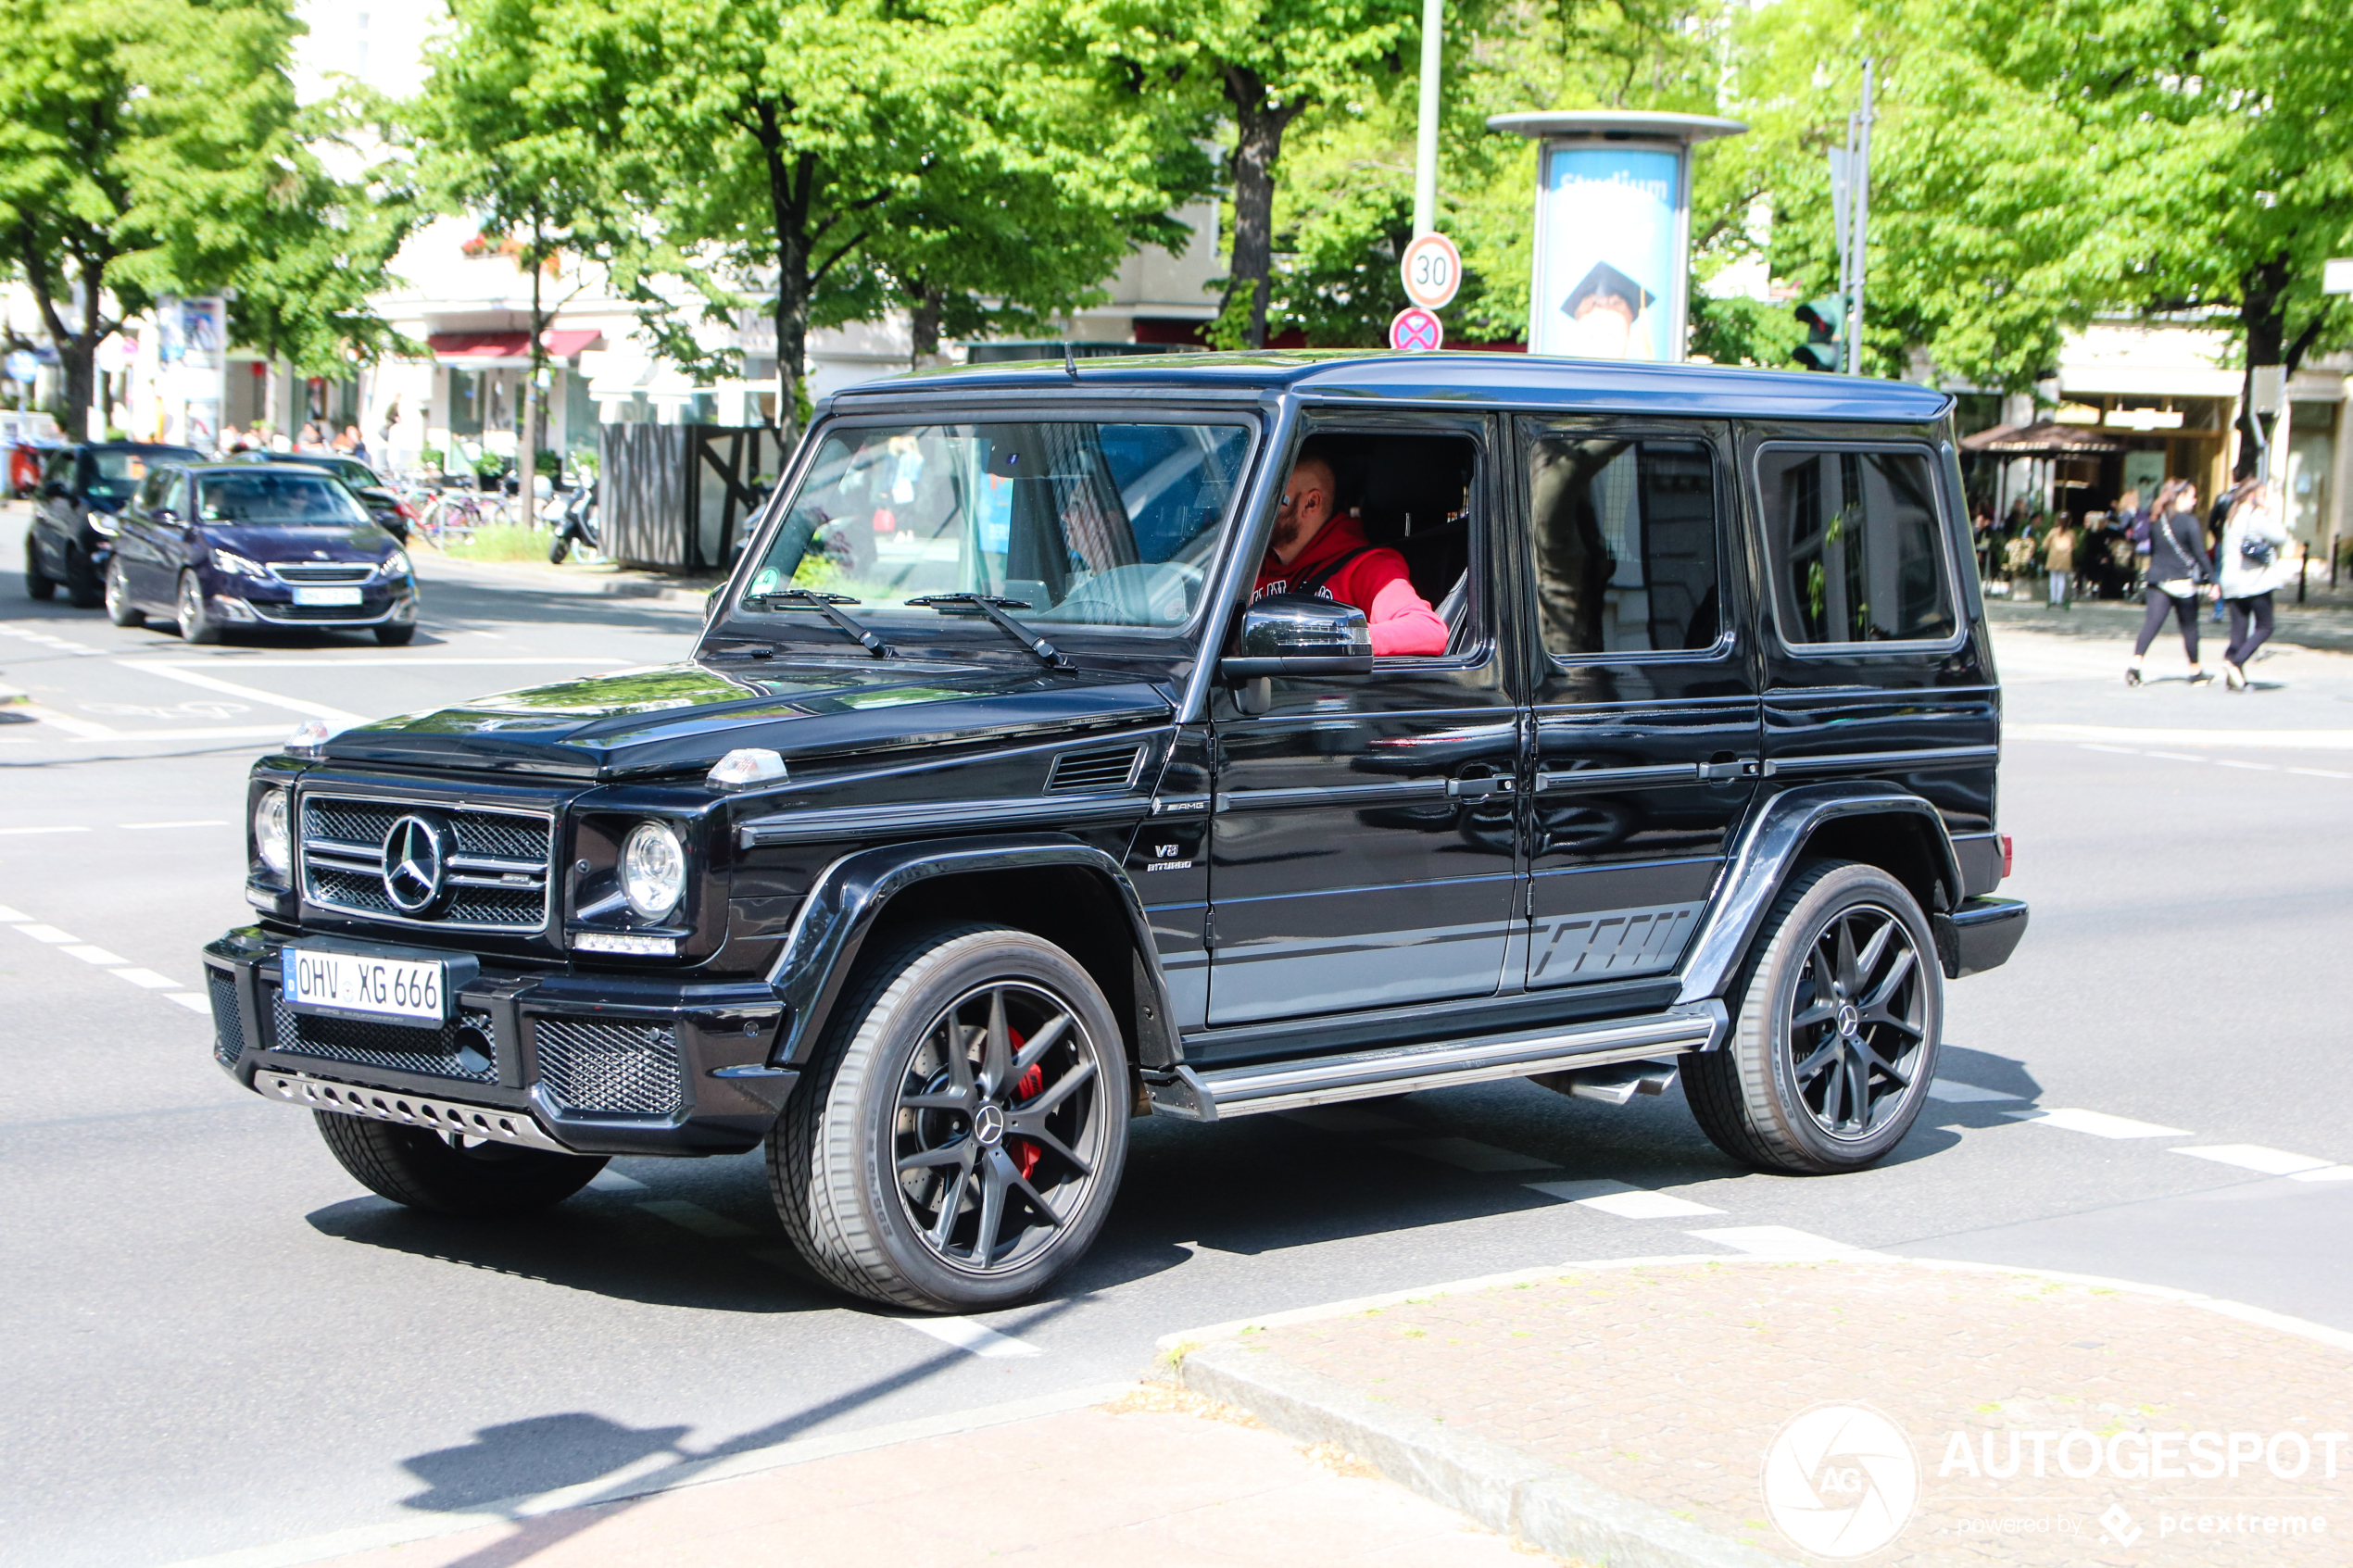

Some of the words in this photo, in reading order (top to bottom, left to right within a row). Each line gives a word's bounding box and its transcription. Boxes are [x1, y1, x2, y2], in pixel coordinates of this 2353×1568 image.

[1416, 255, 1446, 285] 30
[1177, 802, 1204, 810] AMG
[1154, 844, 1179, 858] V8
[1148, 860, 1192, 872] BITURBO
[299, 958, 338, 998] OHV
[359, 963, 387, 1003] XG
[395, 968, 437, 1010] 666
